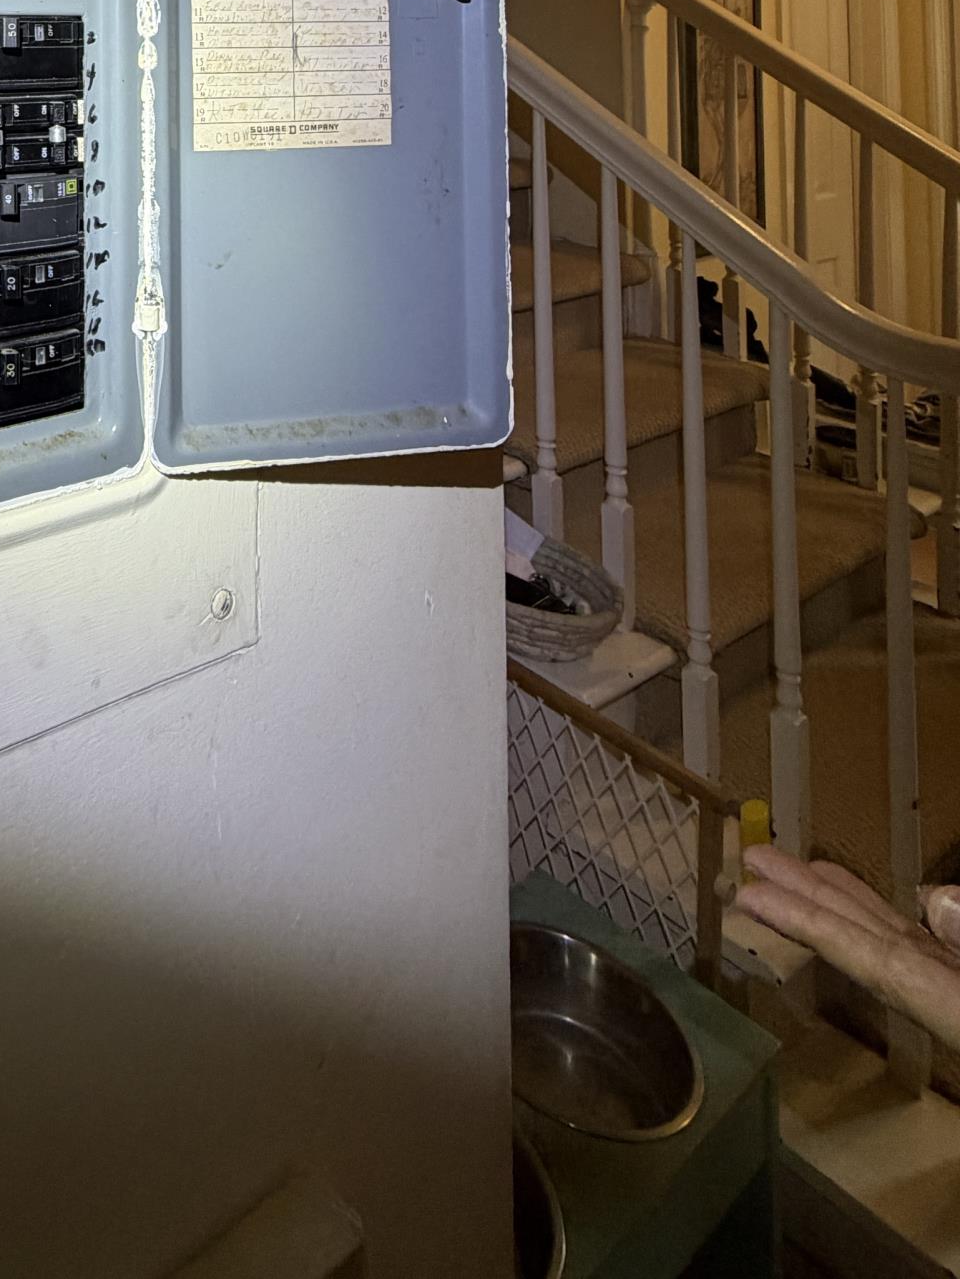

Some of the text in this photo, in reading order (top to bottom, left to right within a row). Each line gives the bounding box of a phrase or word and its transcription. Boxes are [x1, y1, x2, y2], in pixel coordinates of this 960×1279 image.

[194, 8, 202, 17] 11
[378, 6, 387, 15] 12
[8, 23, 17, 37] 50
[378, 31, 387, 39] 14
[195, 32, 204, 41] 13
[195, 57, 204, 67] 15
[378, 54, 388, 63] 16
[196, 82, 205, 92] 17
[380, 79, 388, 88] 18
[41, 104, 48, 115] ON
[196, 108, 205, 118] 19
[379, 103, 389, 113] 20
[250, 123, 340, 135] SQUARE D COMPANY
[41, 147, 48, 158] ON
[5, 194, 12, 205] 40
[7, 276, 16, 291] 20
[7, 363, 16, 378] 30
